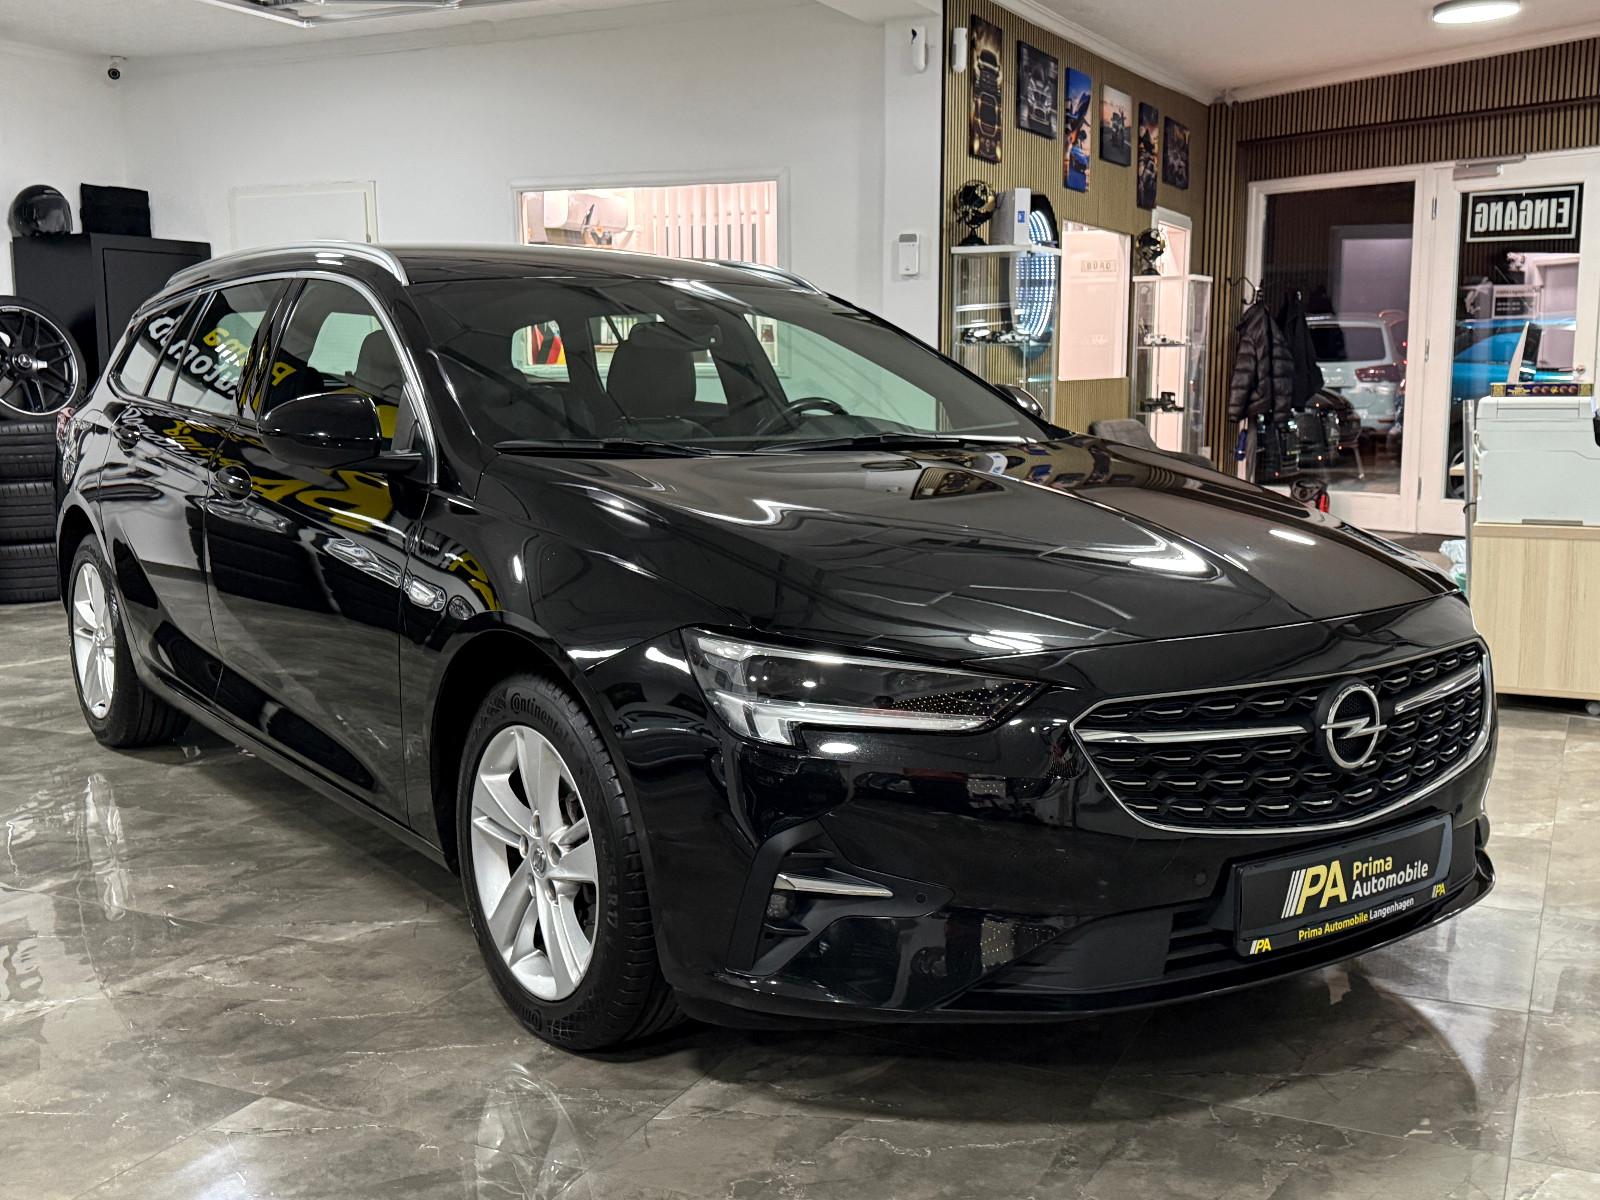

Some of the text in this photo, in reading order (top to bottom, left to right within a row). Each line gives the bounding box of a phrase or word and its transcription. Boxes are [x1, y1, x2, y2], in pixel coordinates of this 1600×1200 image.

[1352, 856, 1393, 880] Prima
[1352, 860, 1429, 900] Automobile
[1298, 897, 1415, 941] Prima Automobile Langenhagen
